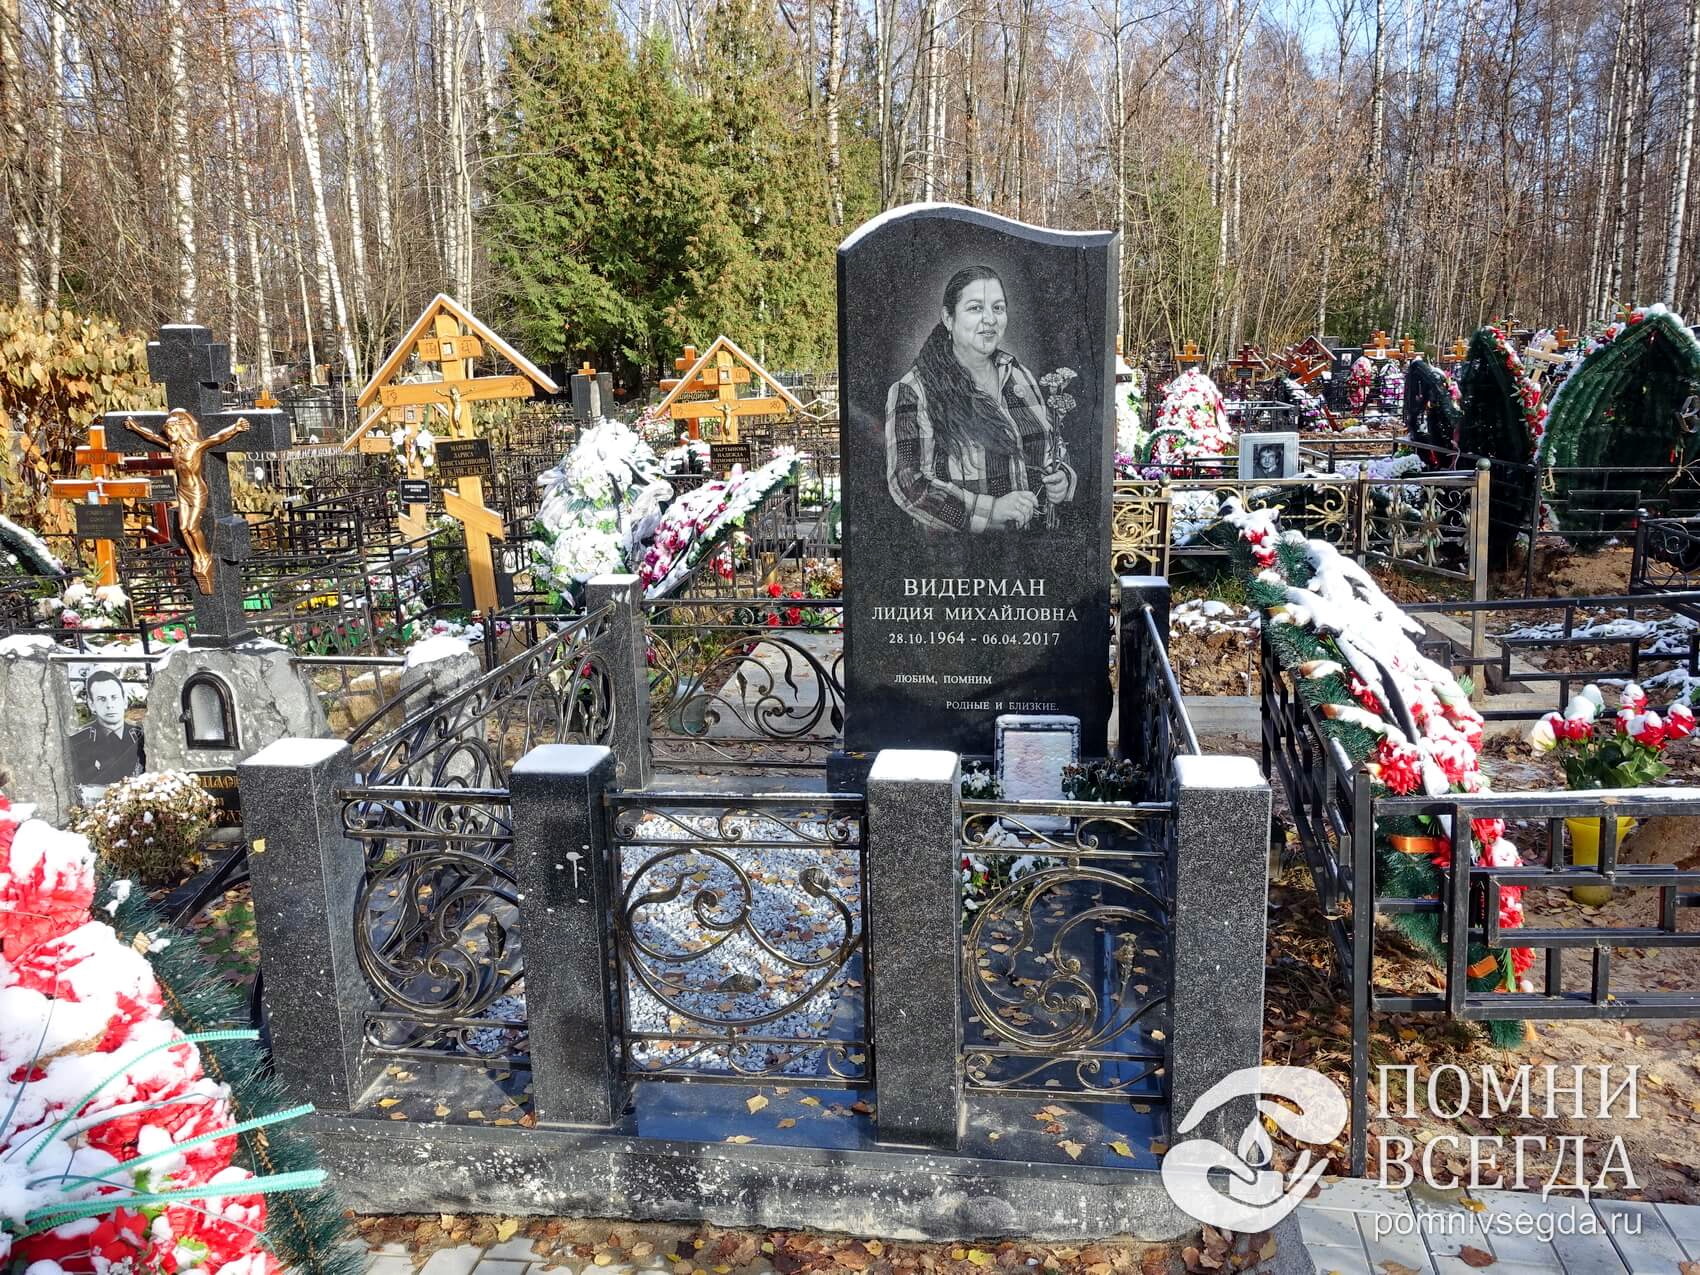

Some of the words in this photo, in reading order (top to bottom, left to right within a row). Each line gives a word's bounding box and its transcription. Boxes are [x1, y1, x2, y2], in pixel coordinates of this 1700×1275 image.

[903, 578, 1046, 600] ВИДЕРМАН
[872, 607, 934, 623] ЛИДИЯ
[945, 605, 1078, 621] МИХАЙЛОВНА
[888, 631, 966, 645] 28.10.1964
[982, 631, 1060, 646] 06.04.2017
[894, 674, 938, 685] ЛЮБИМ,
[943, 674, 993, 685] ПОМНИМ
[946, 700, 990, 711] РОДНЫЕ
[995, 701, 1003, 711] И
[1008, 701, 1060, 712] БЛИЗКИЕ.
